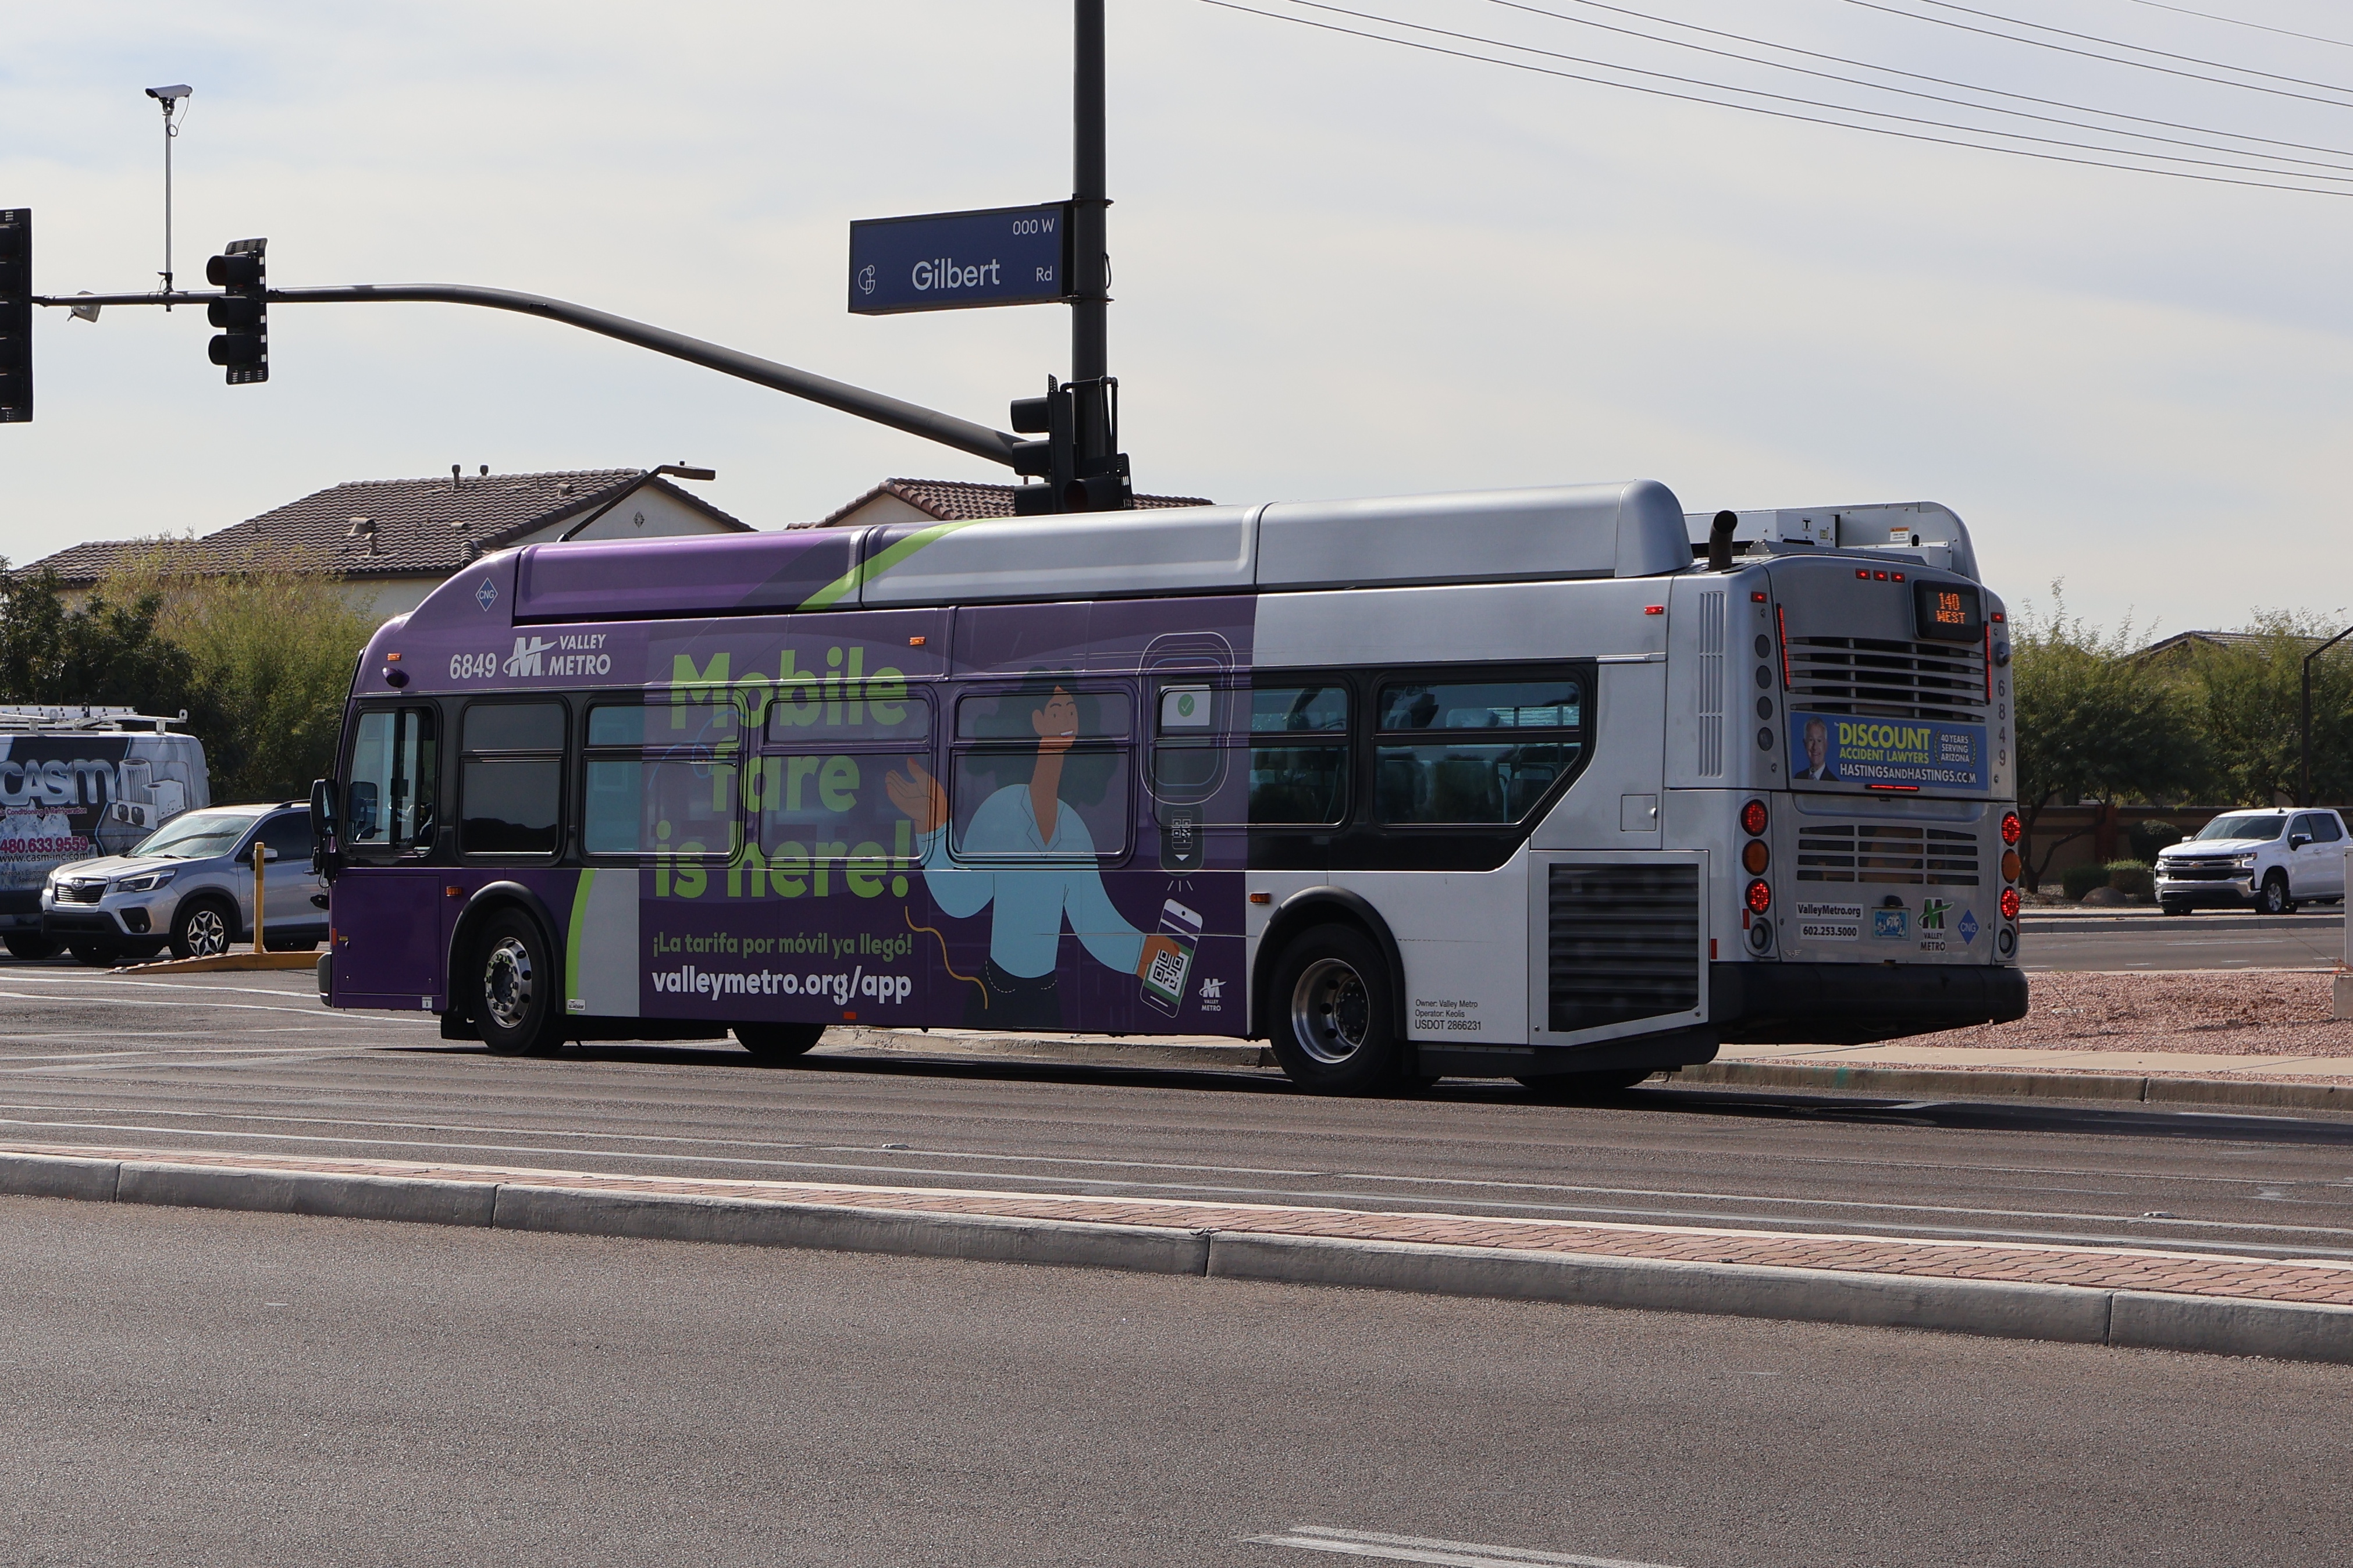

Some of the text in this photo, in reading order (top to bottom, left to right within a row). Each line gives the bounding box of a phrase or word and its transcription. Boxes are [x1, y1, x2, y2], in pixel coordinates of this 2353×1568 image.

[1013, 218, 1055, 235] 000 W
[912, 258, 1052, 291] Gilbert Rd
[479, 590, 494, 600] CNG
[1938, 592, 1960, 610] 140
[1936, 611, 1966, 623] WEST
[559, 634, 607, 650] VALLEY
[450, 653, 611, 679] 6849 METRO
[670, 646, 909, 729] Mobile
[1839, 722, 1931, 750] DISCOUNT
[1941, 734, 1968, 744] 40 YEARS
[1941, 743, 1968, 753] SERVING
[1839, 747, 1929, 764] ACCIDENT LAWYERS
[1941, 753, 1970, 762] ARIZONA
[709, 735, 860, 812] fare
[7, 808, 44, 817] Conditioning
[51, 807, 87, 815] Refrigeration
[0, 836, 88, 854] 480.633.9559
[0, 852, 88, 863] www.casm-inc.com
[655, 819, 911, 898] is here!
[1797, 904, 1861, 917] ValleyMetro.org
[1803, 926, 1857, 936] 602.253.5000
[1960, 922, 1976, 932] CNG
[653, 932, 912, 963] ¡La tarifa por móvil ya llegó!
[1920, 942, 1946, 951] METRO
[652, 965, 912, 1006] valleymetro.org/app
[1439, 1000, 1458, 1008] Valley
[1415, 1009, 1444, 1018] Operator:
[1415, 1020, 1481, 1030] USDOT 2866231
